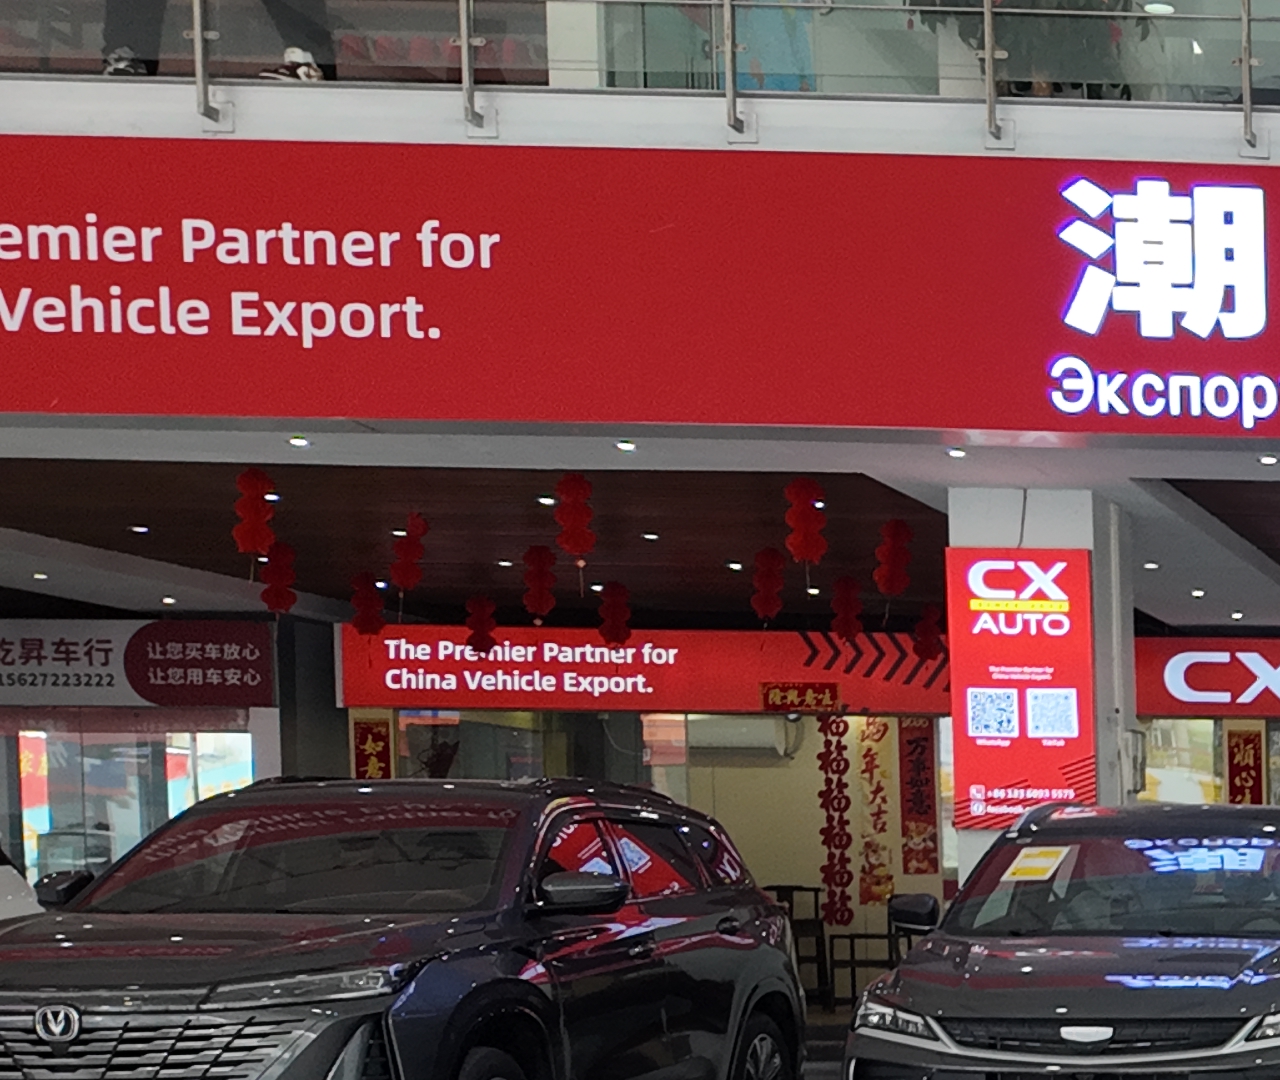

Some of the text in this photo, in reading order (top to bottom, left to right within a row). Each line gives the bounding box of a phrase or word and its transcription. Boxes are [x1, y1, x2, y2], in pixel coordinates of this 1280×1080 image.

[181, 217, 400, 268] Partner
[417, 219, 501, 270] for
[0, 285, 442, 349] Vehicle Export.
[967, 560, 1069, 600] CX
[971, 612, 1071, 636] AUTO
[146, 642, 261, 660] 让您买车放心
[384, 639, 431, 661] The
[542, 642, 637, 665] Partner
[641, 643, 679, 665] for
[147, 667, 262, 686] 让您用车安心
[384, 668, 654, 697] China Vehicle Export.
